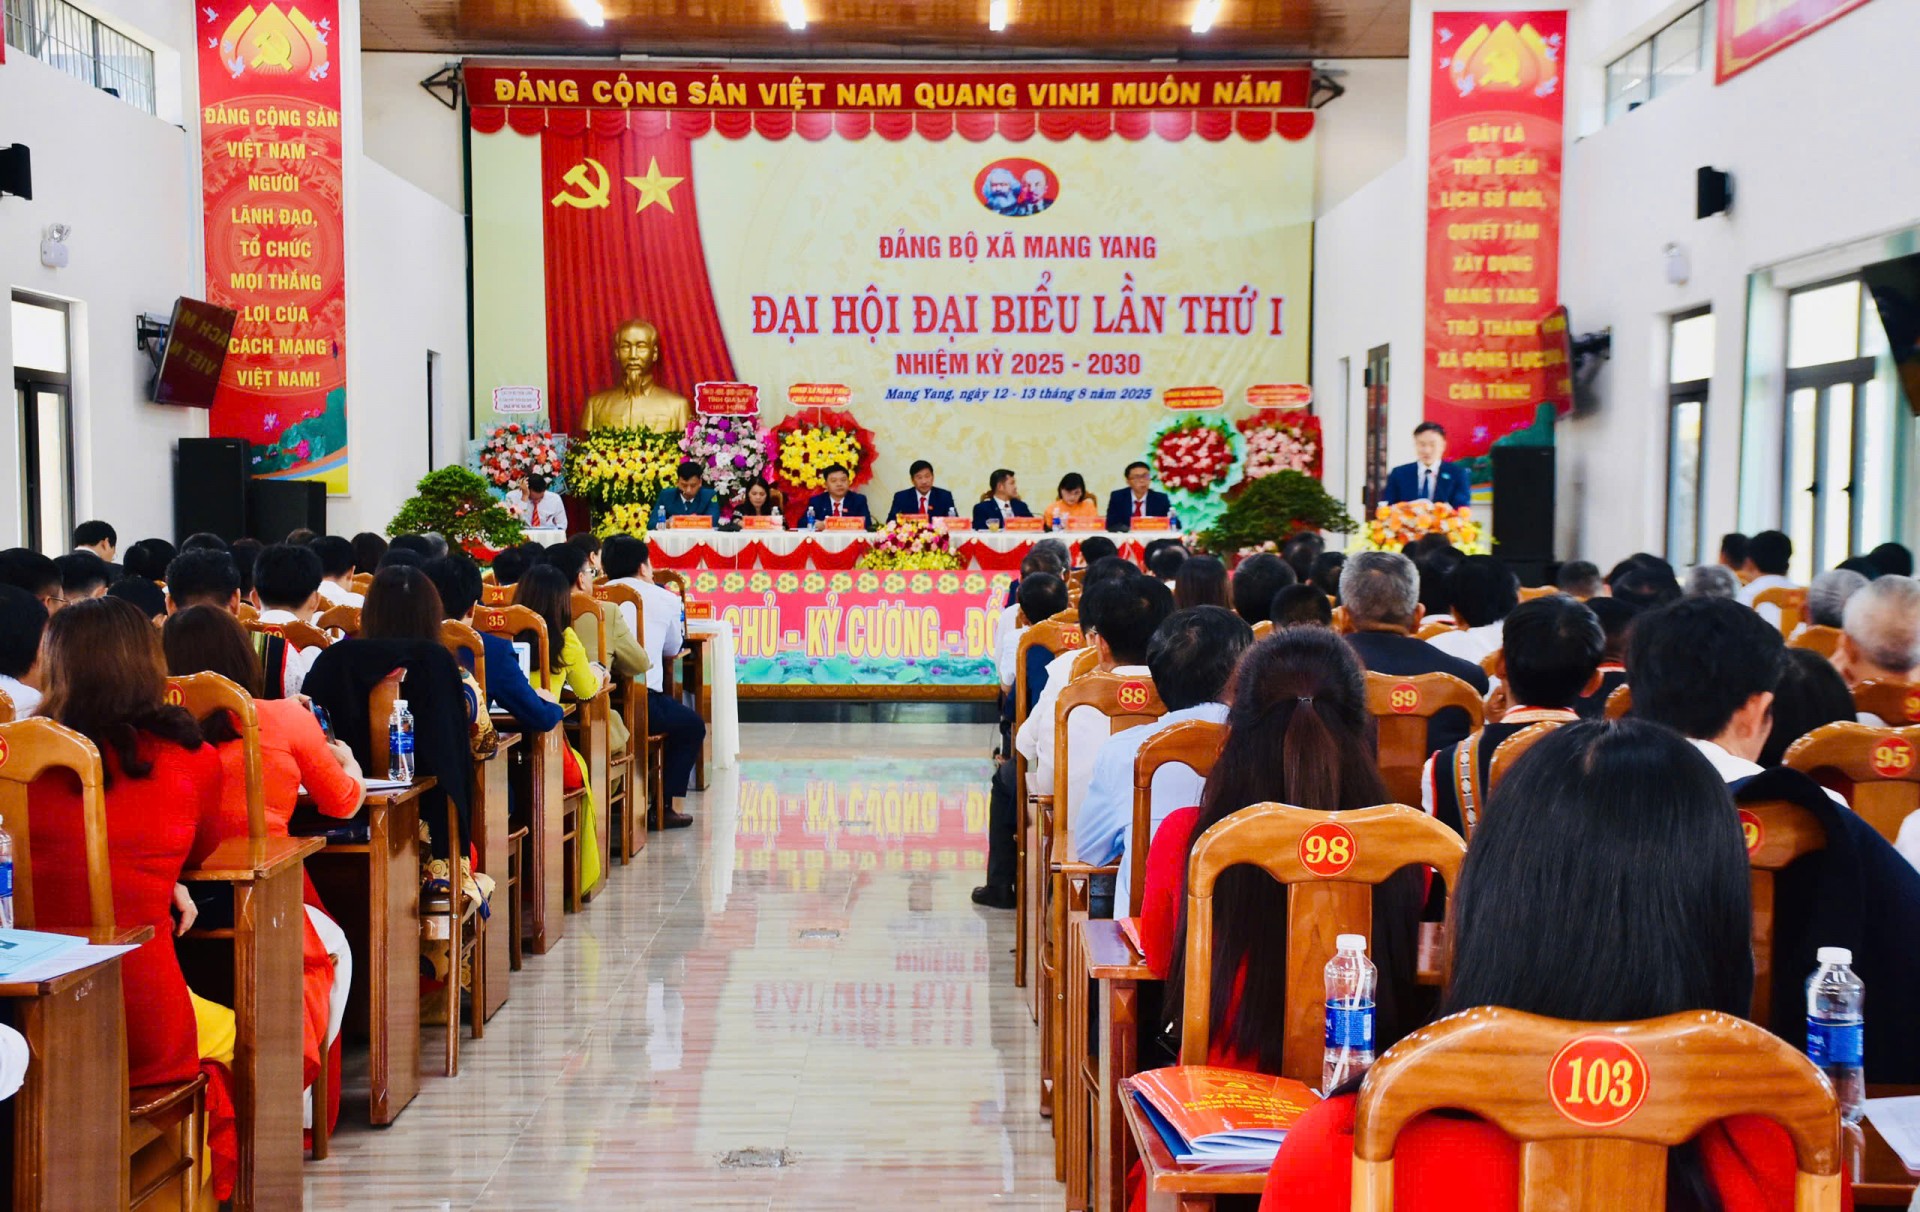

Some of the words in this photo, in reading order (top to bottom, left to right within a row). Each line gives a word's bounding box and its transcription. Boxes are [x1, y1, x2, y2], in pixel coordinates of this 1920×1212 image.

[495, 71, 579, 103] ĐẢNG
[593, 73, 678, 108] CỘNG
[688, 75, 746, 106] SẢN
[758, 76, 825, 110] VIỆT
[837, 83, 901, 106] NAM
[914, 83, 1016, 109] QUANG
[1028, 83, 1099, 106] VINH
[1112, 74, 1200, 105] MUÔN
[1213, 74, 1282, 105] NĂM
[205, 104, 249, 126] ĐẢNG
[255, 106, 301, 129] CỘNG
[306, 106, 338, 127] SẢN
[227, 139, 263, 161] VIỆT
[269, 144, 305, 159] NAM
[248, 173, 299, 192] NGƯỜI
[231, 205, 273, 224] LÃNH
[279, 209, 318, 227] ĐẠO,
[240, 234, 260, 258] TỔ
[266, 238, 312, 258] CHỨC
[879, 228, 941, 258] ĐẢNG
[950, 231, 978, 263] BỘ
[986, 231, 1016, 258] XÃ
[1023, 236, 1091, 259] MANG
[1100, 236, 1157, 259] YANG
[230, 273, 263, 292] MỌI
[268, 268, 322, 291] THẮNG
[244, 306, 270, 324] LỢI
[275, 302, 309, 322] CỦA
[752, 295, 819, 344] ĐẠI
[832, 284, 900, 344] HỘI
[912, 295, 979, 343] ĐẠI
[992, 271, 1080, 334] BIỂU
[1093, 272, 1166, 334] LẦN
[1179, 285, 1258, 335] THỨ
[1270, 298, 1283, 335] I
[229, 333, 274, 355] CÁCH
[279, 339, 327, 357] MẠNG
[896, 349, 968, 379] NHIỆM
[976, 349, 1004, 375] KỲ
[1011, 353, 1064, 375] 2025
[1088, 353, 1141, 375] 2030
[237, 367, 272, 389] VIỆT
[278, 371, 320, 387] NAM!
[885, 388, 919, 402] Mang
[923, 388, 955, 402] Yang,
[959, 389, 988, 402] ngày
[993, 388, 1009, 399] 12
[1020, 388, 1036, 399] 13
[1039, 388, 1074, 402] tháng
[1078, 388, 1086, 399] 8
[1089, 388, 1116, 399] năm
[1120, 388, 1152, 399] 2025
[491, 593, 504, 601] 24
[488, 615, 505, 626] 35
[722, 591, 779, 657] CHỦ
[787, 631, 799, 644] -
[807, 592, 842, 657] KỶ
[849, 601, 939, 657] CƯƠNG
[947, 632, 959, 644] -
[966, 588, 1001, 657] ĐỔ
[1061, 632, 1080, 645] 78
[163, 689, 182, 706] 0
[1120, 687, 1146, 704] 88
[1390, 691, 1417, 707] 89
[1905, 697, 1920, 714] 9
[1875, 746, 1910, 768] 95
[1742, 822, 1759, 849] 9
[1305, 835, 1350, 865] 98
[1565, 1057, 1633, 1107] 103
